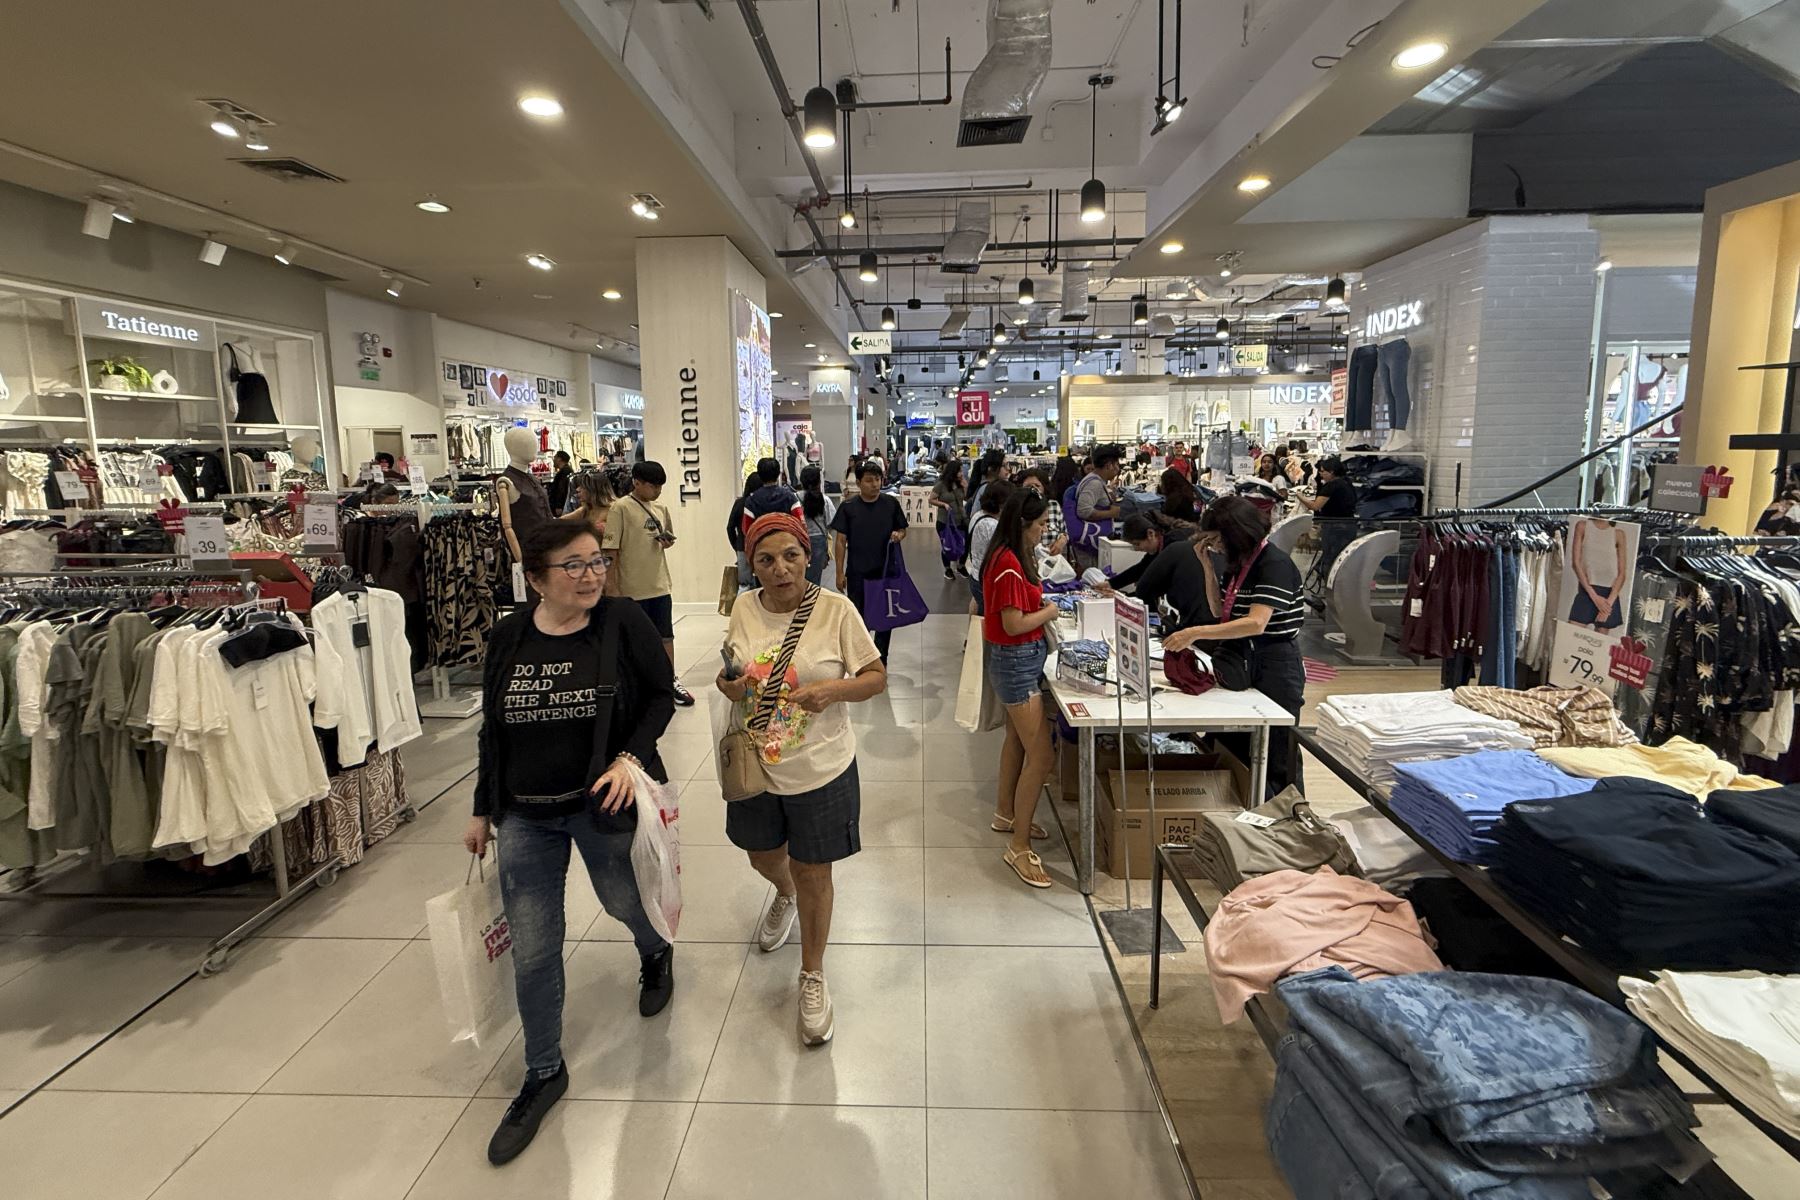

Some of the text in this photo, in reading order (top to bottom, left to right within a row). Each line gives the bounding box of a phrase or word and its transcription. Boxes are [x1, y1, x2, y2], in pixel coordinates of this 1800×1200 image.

[1366, 300, 1422, 337] INDEX
[101, 311, 199, 341] Tatienne
[1246, 351, 1264, 362] SALIDA
[816, 383, 842, 393] KAYRA
[1269, 386, 1332, 404] INDEX
[962, 411, 985, 422] QUI
[792, 423, 808, 431] caja
[677, 367, 702, 507] Tatienne
[312, 523, 328, 536] 69
[198, 540, 216, 554] 39
[513, 662, 572, 677] DO NOT
[507, 679, 553, 692] READ
[504, 688, 597, 709] THE NEXT
[504, 704, 597, 723] SENTENCE
[1145, 787, 1207, 796] ETE LADO ARRIBA
[1168, 825, 1191, 834] PAC
[1168, 834, 1190, 843] PAC
[480, 924, 491, 937] LO
[487, 936, 512, 963] fas
